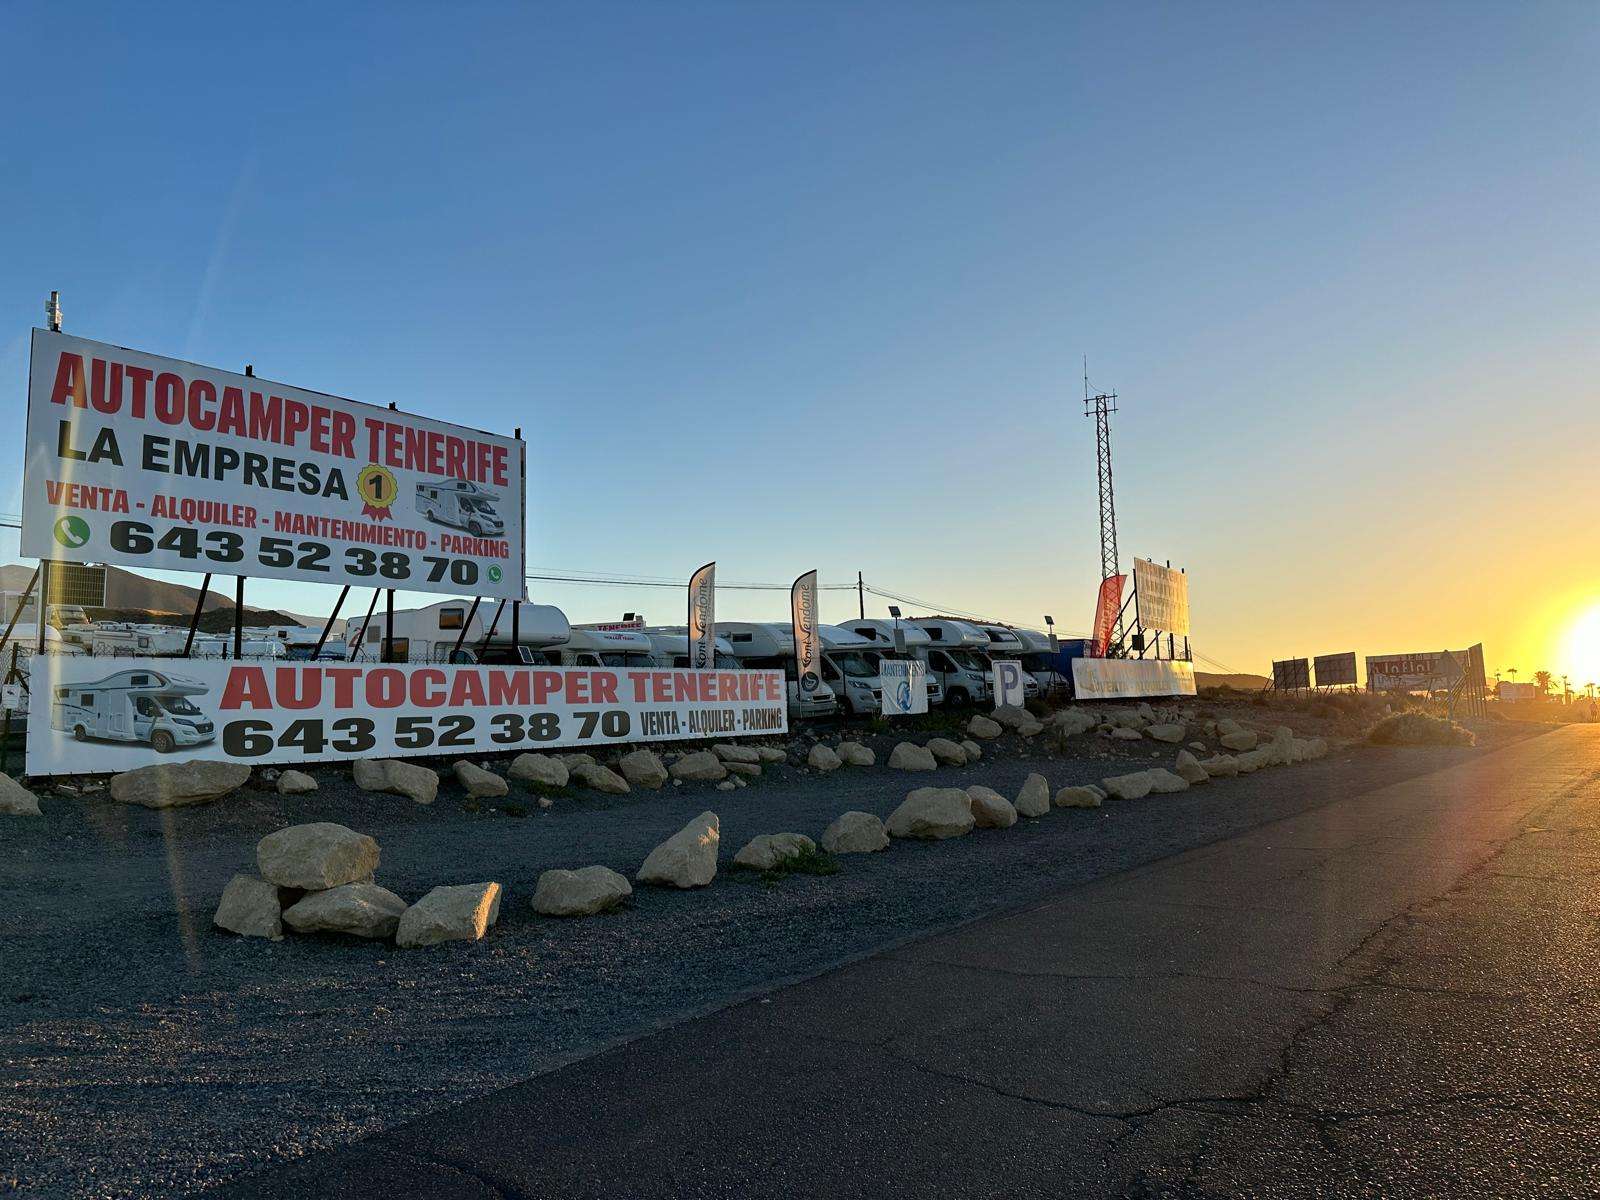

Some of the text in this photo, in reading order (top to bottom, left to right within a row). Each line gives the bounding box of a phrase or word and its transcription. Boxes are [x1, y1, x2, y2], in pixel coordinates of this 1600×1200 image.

[51, 351, 509, 487] AUTOCAMPER TENERIFE
[57, 420, 384, 500] LA EMPRESA 1
[45, 480, 129, 514] VENTA
[151, 494, 257, 529] ALQUILER
[274, 511, 428, 551] MANTENIMIENTO
[441, 534, 510, 559] PARKING
[110, 520, 479, 586] 643 52 38 70
[219, 666, 782, 711] AUTOCAMPER TENERIFE
[1000, 664, 1018, 704] P
[222, 710, 631, 758] 643 52 38 70
[640, 711, 680, 736] VENTA
[688, 709, 736, 736] ALQUILER
[742, 707, 782, 731] PARKING
